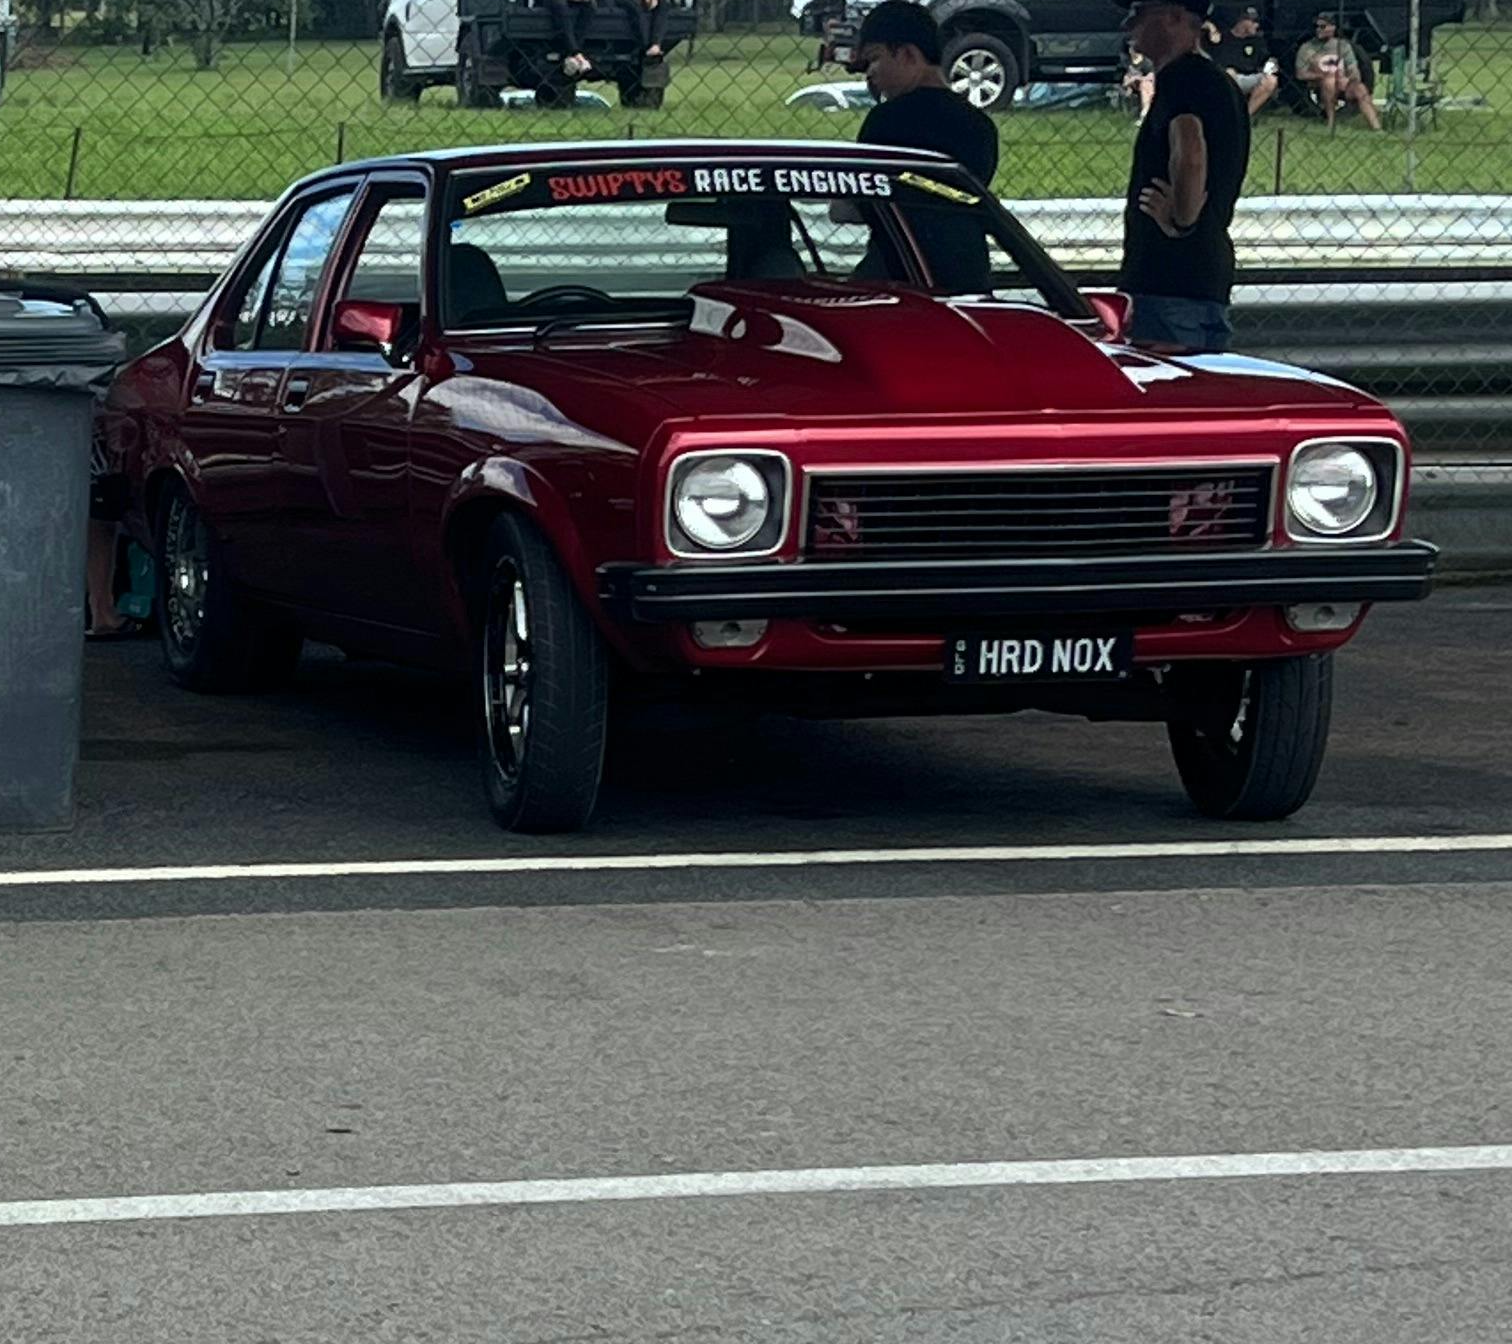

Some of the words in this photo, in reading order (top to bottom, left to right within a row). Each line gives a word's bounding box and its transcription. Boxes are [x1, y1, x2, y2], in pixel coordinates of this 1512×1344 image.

[694, 168, 765, 193] RACE
[774, 169, 892, 196] ENGINES
[979, 639, 1044, 674] HRD
[1052, 637, 1117, 673] NOX
